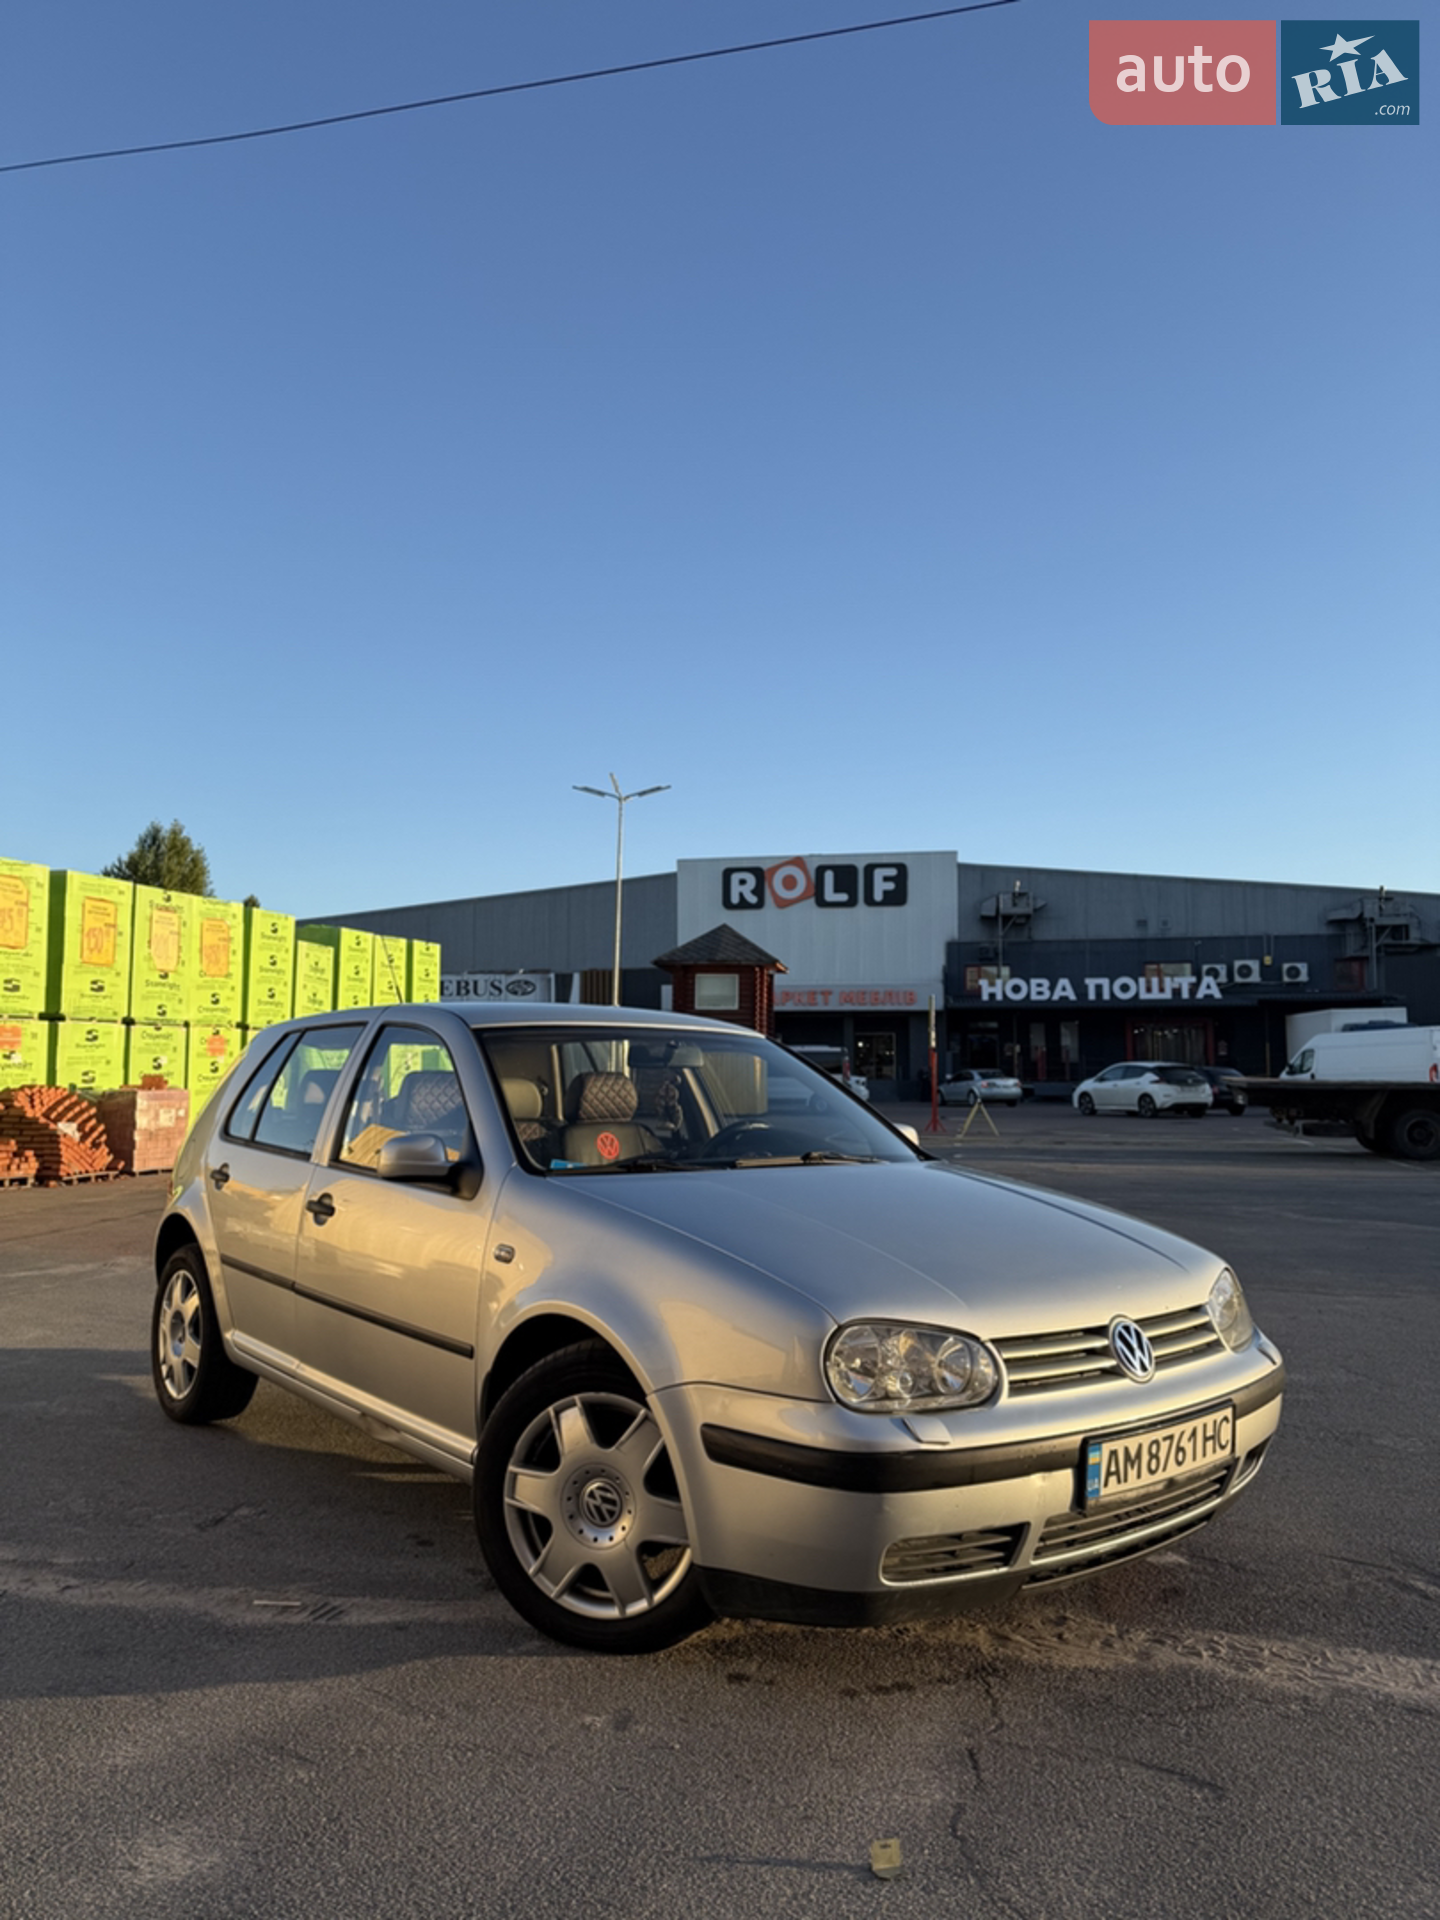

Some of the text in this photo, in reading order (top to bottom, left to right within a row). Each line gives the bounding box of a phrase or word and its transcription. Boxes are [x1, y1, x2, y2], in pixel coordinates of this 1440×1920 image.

[730, 864, 898, 905] ROLF
[774, 988, 833, 1006] РКЕТ
[978, 975, 1223, 1001] НОВА ПОШТА
[1103, 1415, 1231, 1489] AM 8761 HC
